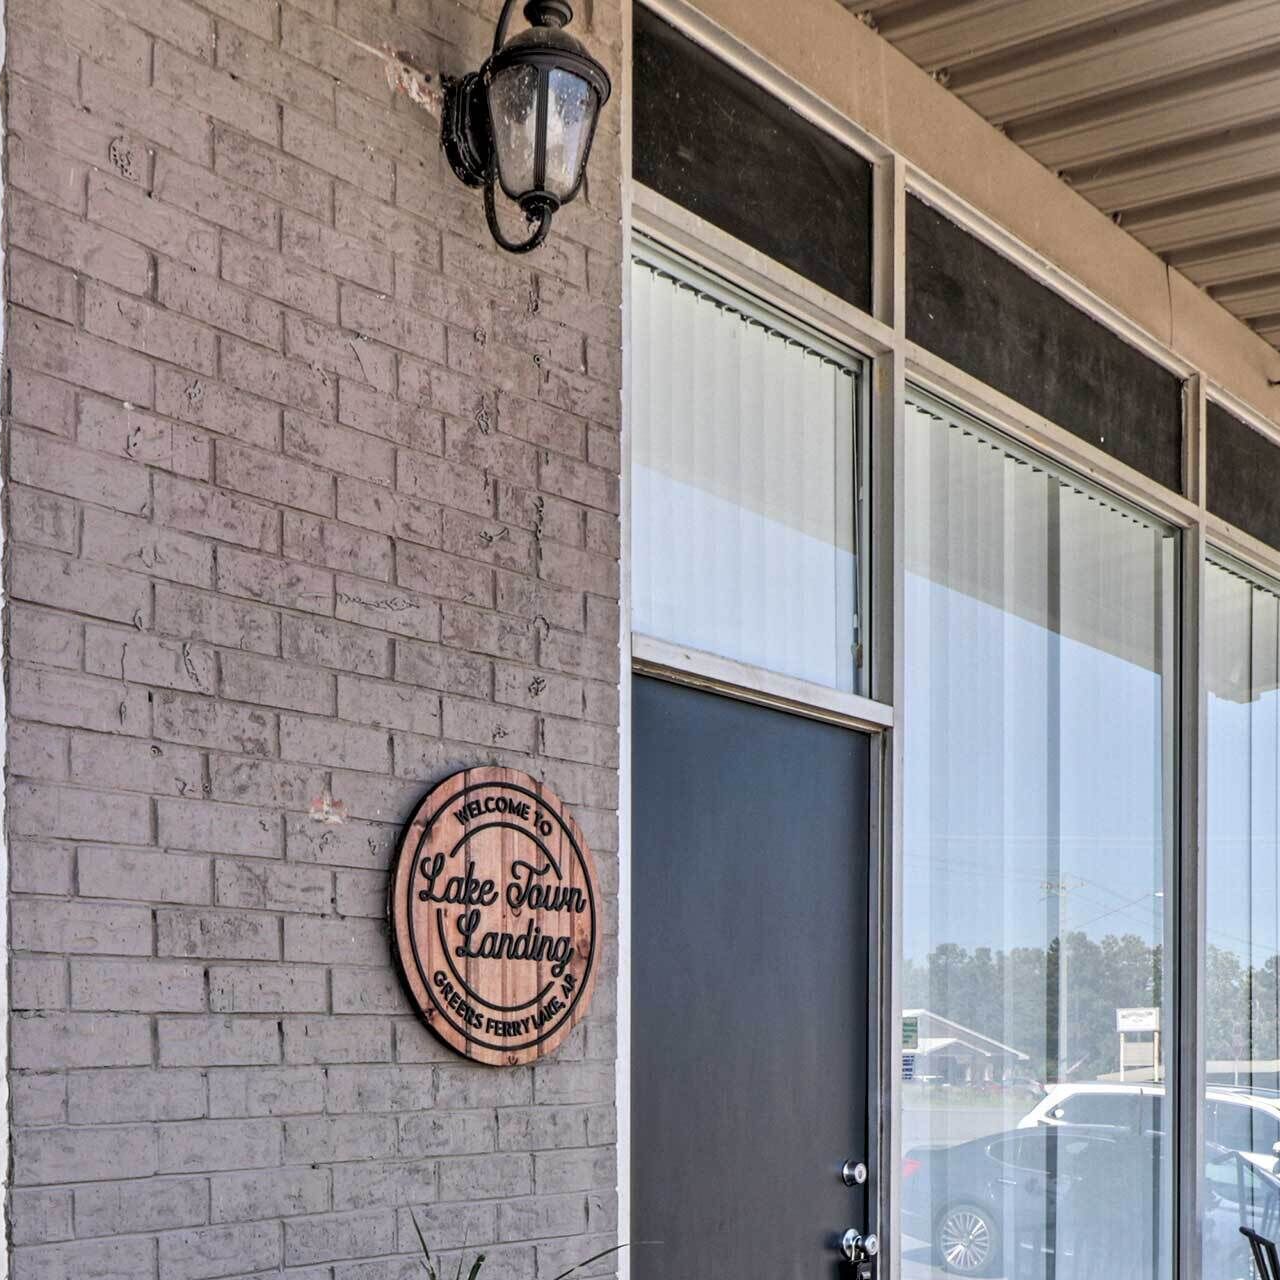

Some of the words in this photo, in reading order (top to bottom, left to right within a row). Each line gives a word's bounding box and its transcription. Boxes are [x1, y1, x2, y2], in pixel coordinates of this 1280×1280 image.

[453, 796, 531, 826] WELCOME
[534, 809, 553, 837] TO
[419, 852, 499, 906] Lake
[505, 860, 587, 914] Town
[456, 909, 575, 978] Landing
[433, 970, 485, 1030] GREERS
[485, 1016, 531, 1037] FERRY
